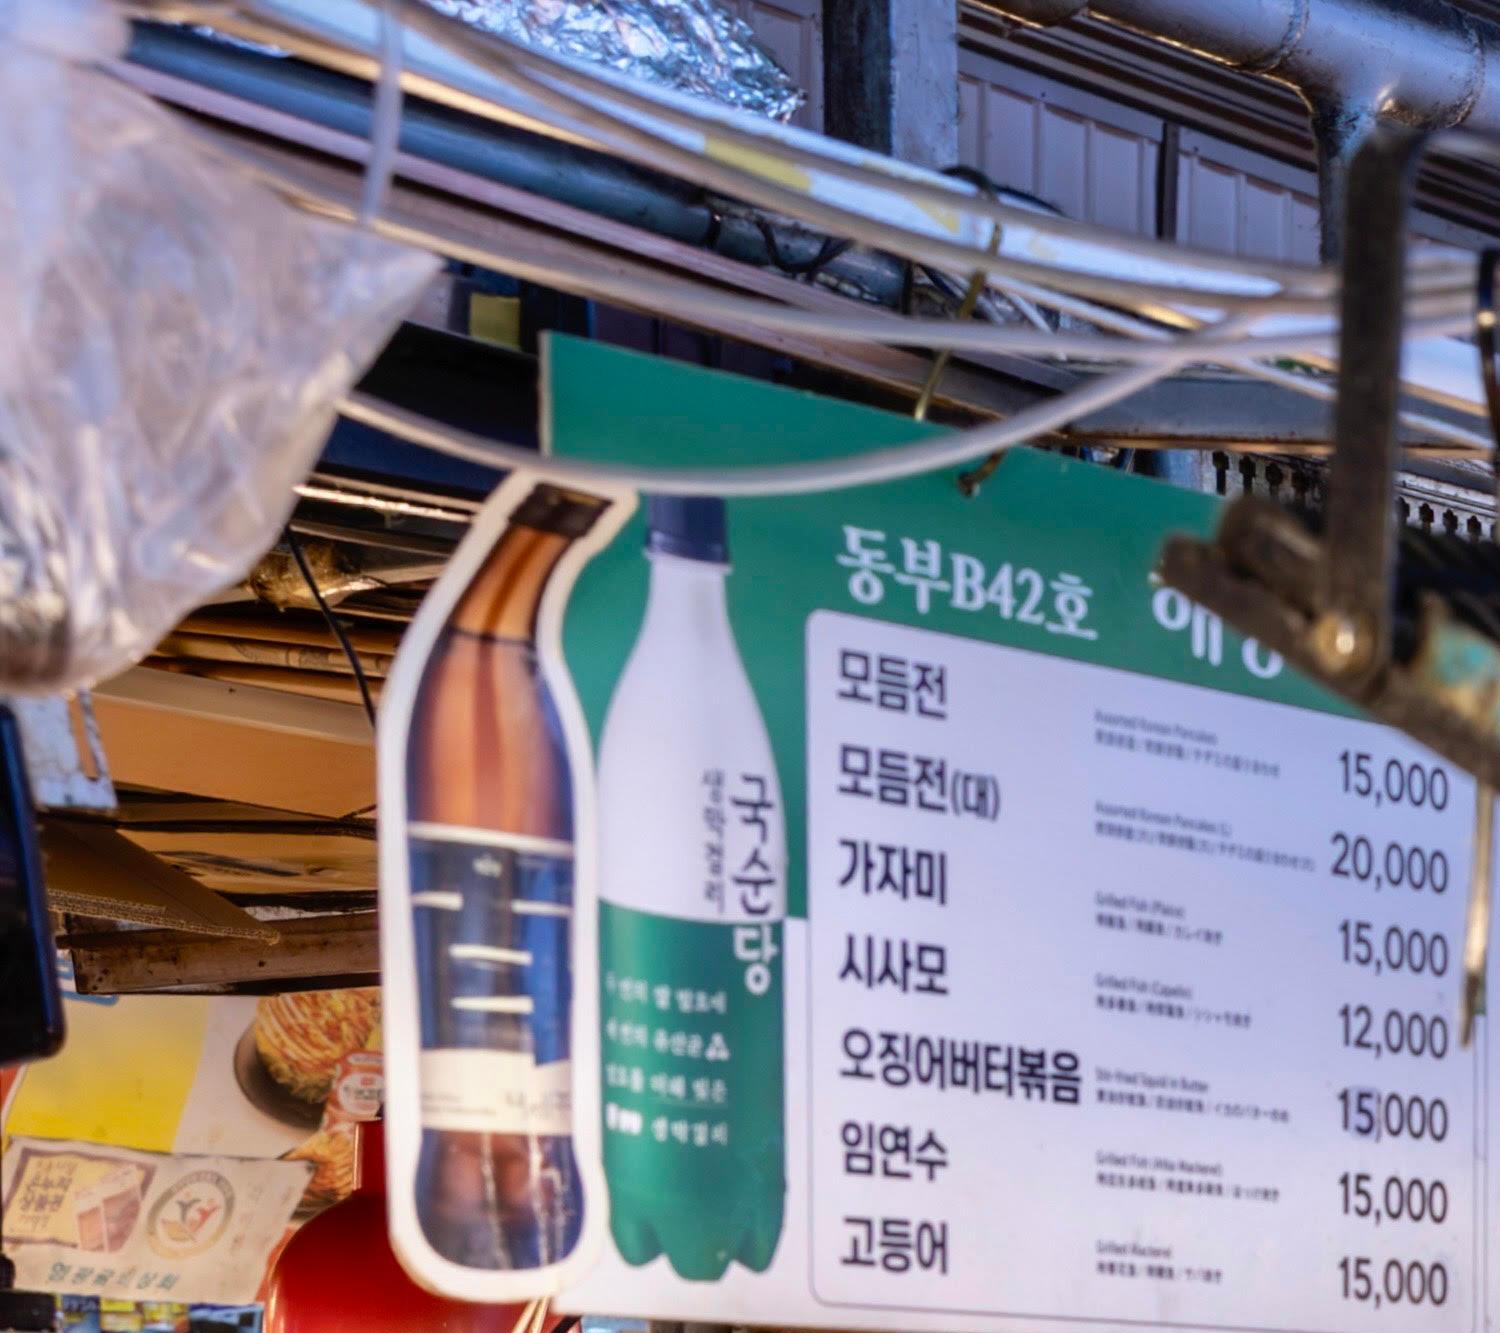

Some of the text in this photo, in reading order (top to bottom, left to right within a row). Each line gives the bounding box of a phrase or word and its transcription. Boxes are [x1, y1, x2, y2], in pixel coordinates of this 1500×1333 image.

[836, 525, 1098, 641] 동부B42호
[838, 648, 948, 720] 모듬전
[838, 743, 1001, 824] 모듬전(대)
[1339, 750, 1449, 810] 15,000
[733, 773, 779, 996] 국순당
[838, 838, 948, 906] 가자미
[1331, 832, 1449, 894] 20,000
[839, 933, 949, 996] 시사모
[1339, 920, 1449, 977] 15,000
[1339, 1004, 1449, 1060] 12,000
[839, 1027, 1082, 1105] 오징어버터볶음
[840, 1120, 949, 1182] 임연수
[1339, 1173, 1449, 1224] 15,000
[840, 1216, 949, 1275] 고등어
[1339, 1257, 1448, 1309] 15,000
